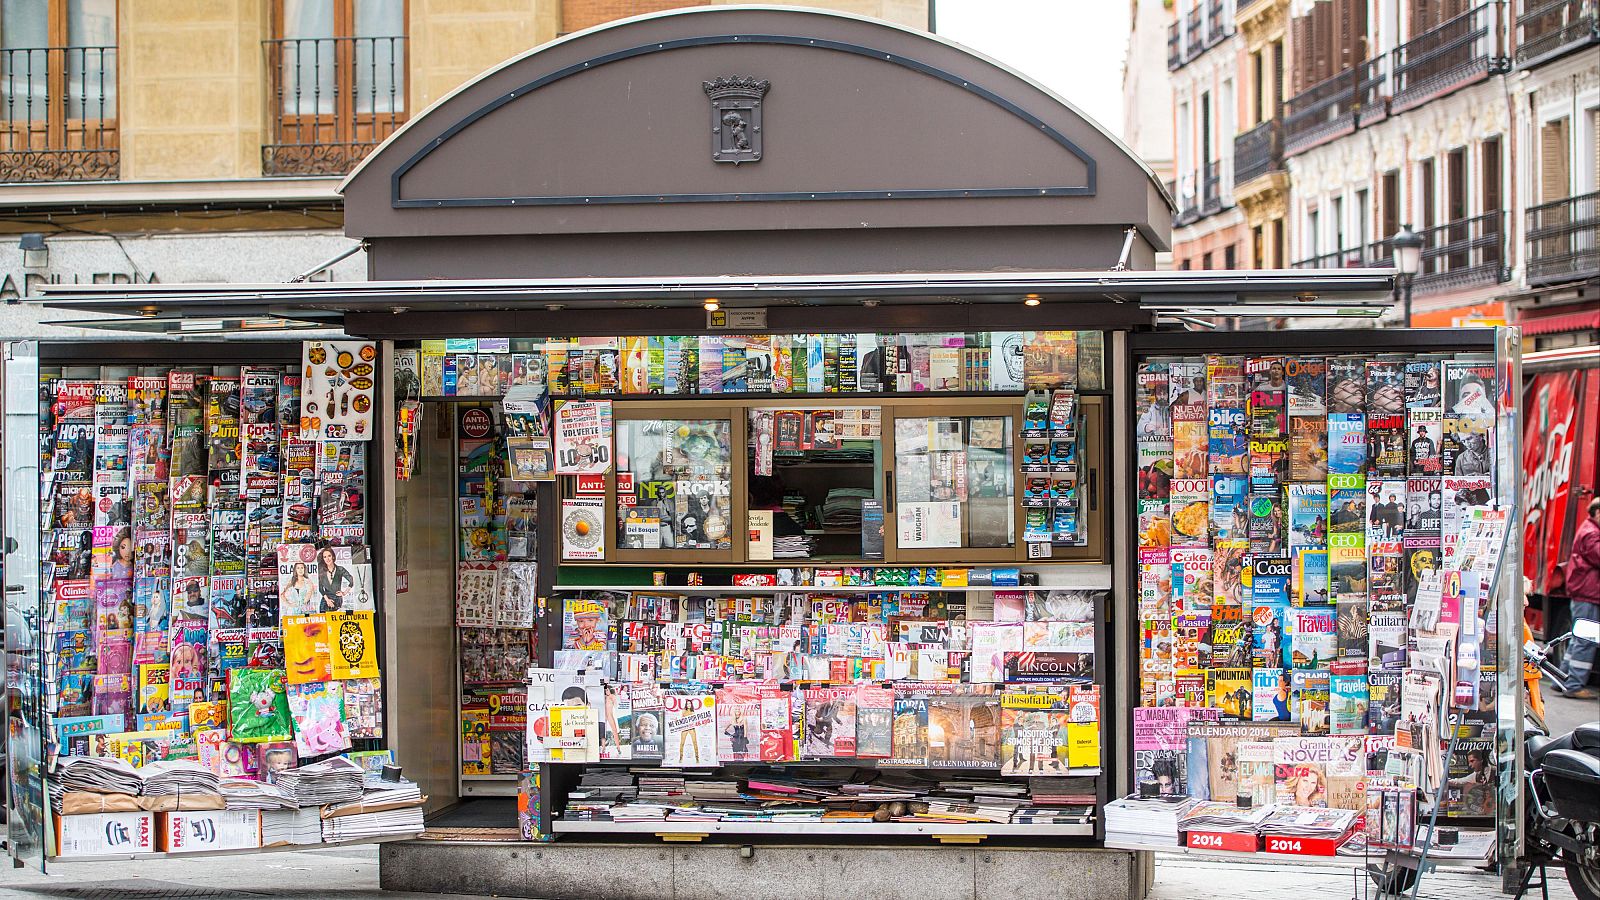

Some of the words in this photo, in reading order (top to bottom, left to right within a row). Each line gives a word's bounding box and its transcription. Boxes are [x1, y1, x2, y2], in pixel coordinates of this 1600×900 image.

[171, 373, 193, 383] caza
[1210, 410, 1245, 425] bike
[563, 427, 598, 438] VOLVERTE
[1141, 448, 1173, 457] Thermo
[1330, 476, 1357, 488] GEO
[1421, 518, 1440, 528] BIFF
[94, 527, 112, 536] TOP
[324, 529, 341, 537] SOLO
[342, 528, 364, 537] MOTO
[638, 526, 658, 534] Bosque
[1330, 535, 1357, 547] GEO
[287, 617, 295, 625] EL
[296, 616, 326, 624] CULTURAL
[225, 645, 244, 656] 322
[1017, 662, 1076, 672] LINCOLN
[1215, 670, 1251, 680] MOUNTAIN
[806, 690, 855, 699] HISTORIA
[490, 695, 500, 715] 9
[1002, 695, 1040, 706] Filosofía
[155, 722, 182, 731] Maya
[676, 718, 687, 727] VENDO
[1017, 730, 1053, 738] NOSOTROS
[1189, 727, 1247, 736] CALENDARIO
[1249, 727, 1269, 736] 2014
[1007, 738, 1029, 746] SOMOS
[1031, 738, 1063, 746] MEJORES
[1300, 739, 1341, 750] Grandes
[1283, 749, 1357, 762] NOVELAS
[981, 760, 997, 768] 2014
[1192, 835, 1223, 846] 2014
[1270, 839, 1301, 851] 2014
